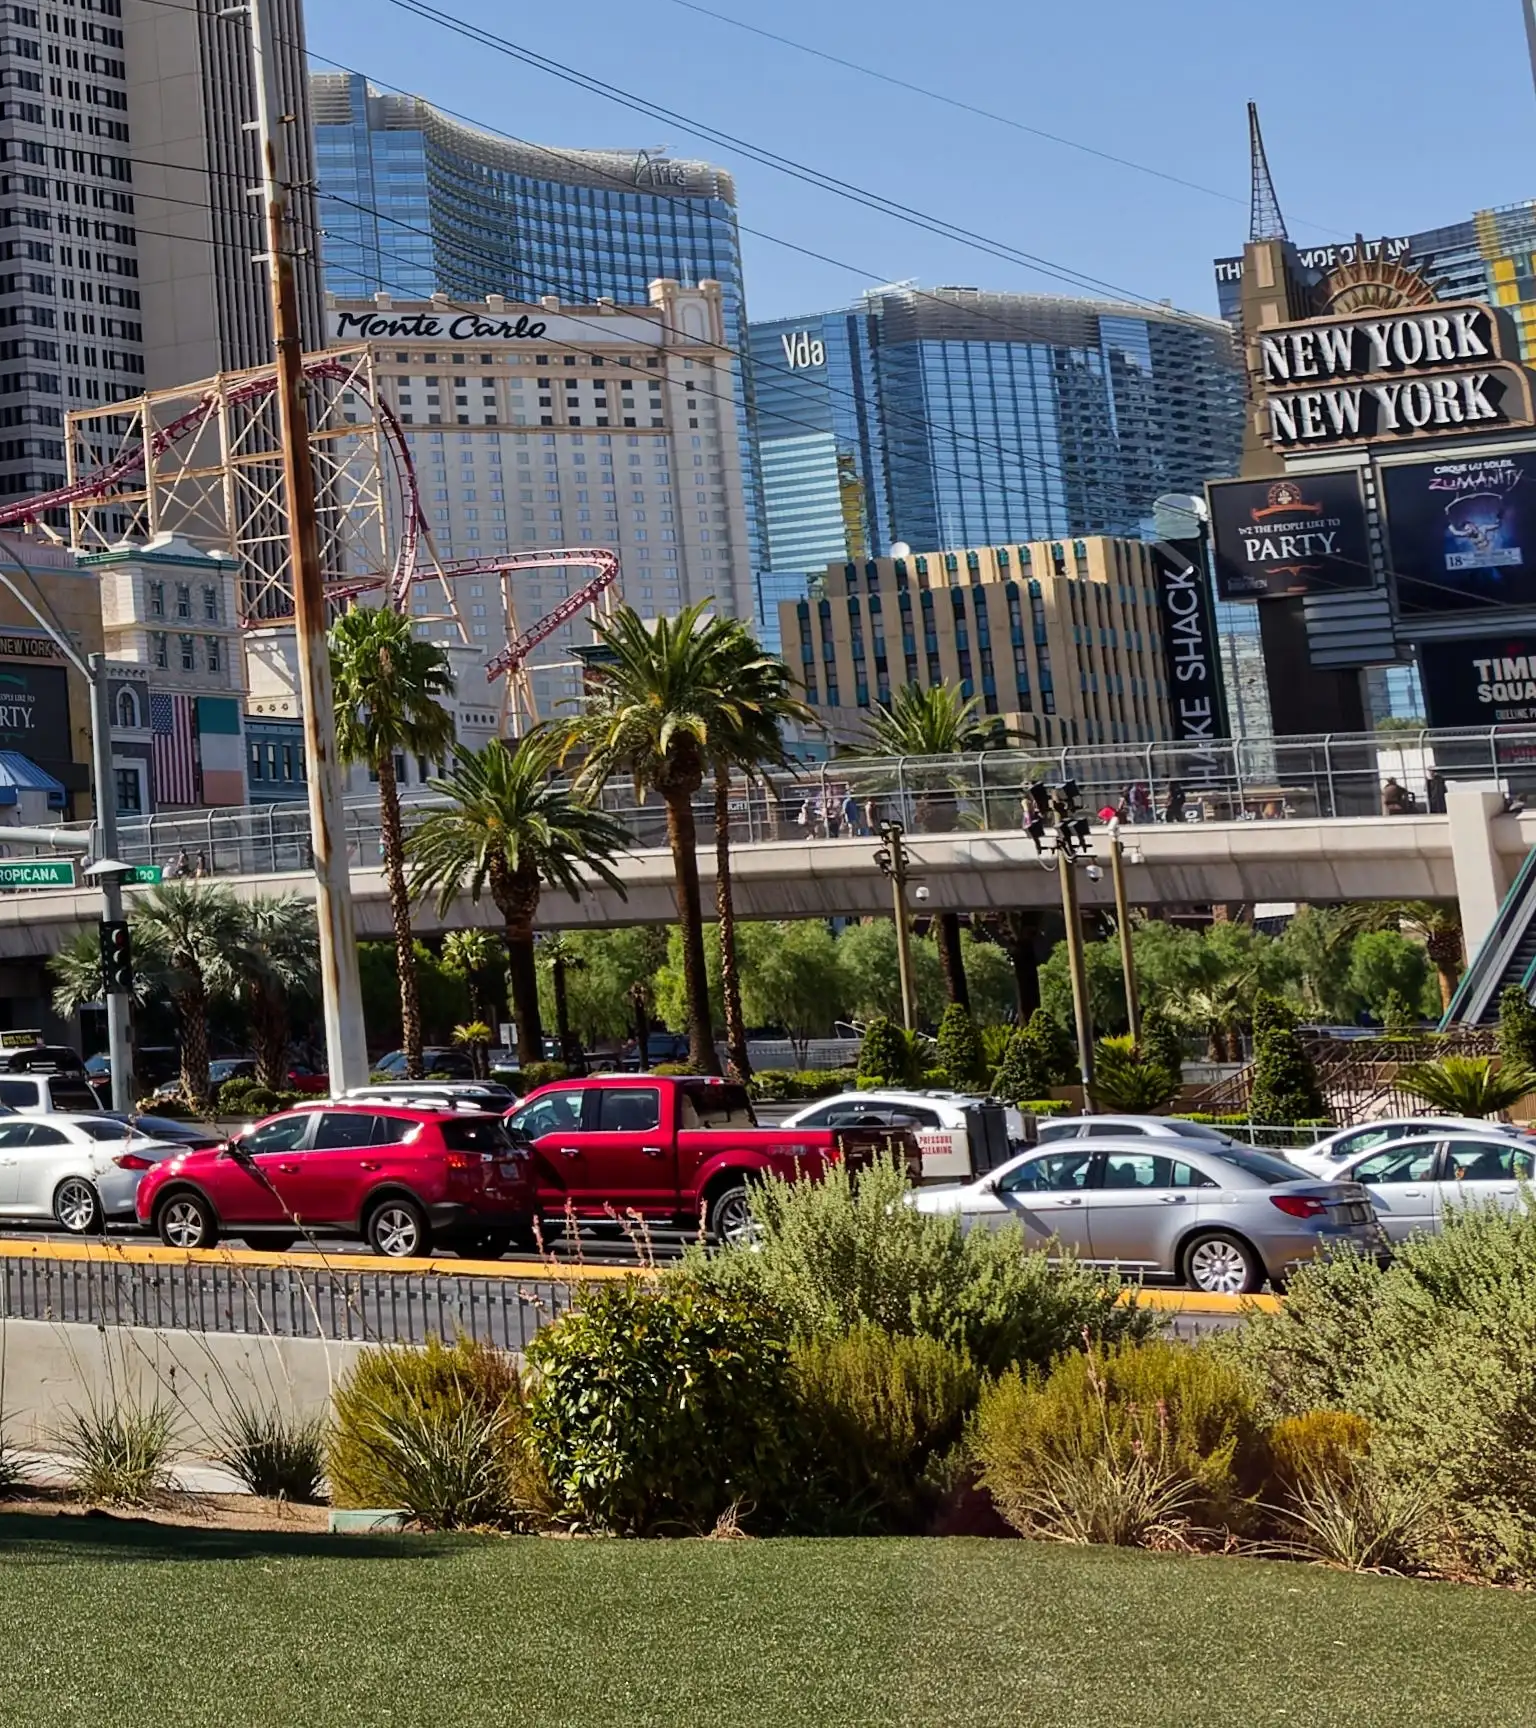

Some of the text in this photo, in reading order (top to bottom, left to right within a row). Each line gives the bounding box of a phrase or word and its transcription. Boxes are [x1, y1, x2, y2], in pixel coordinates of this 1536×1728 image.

[1215, 261, 1245, 281] TH
[337, 312, 547, 340] Monte Carlo
[1261, 312, 1488, 381] NEW YORK
[1269, 373, 1498, 441] NEW YORK
[1429, 468, 1524, 491] ZUMANITY
[1254, 525, 1271, 534] THE
[1273, 522, 1305, 533] PEOPLE
[1307, 520, 1325, 529] LIKE
[1327, 518, 1341, 527] TO
[1244, 532, 1341, 562] PARTY.
[1165, 565, 1208, 681] SHACK
[1182, 696, 1221, 789] HAKE
